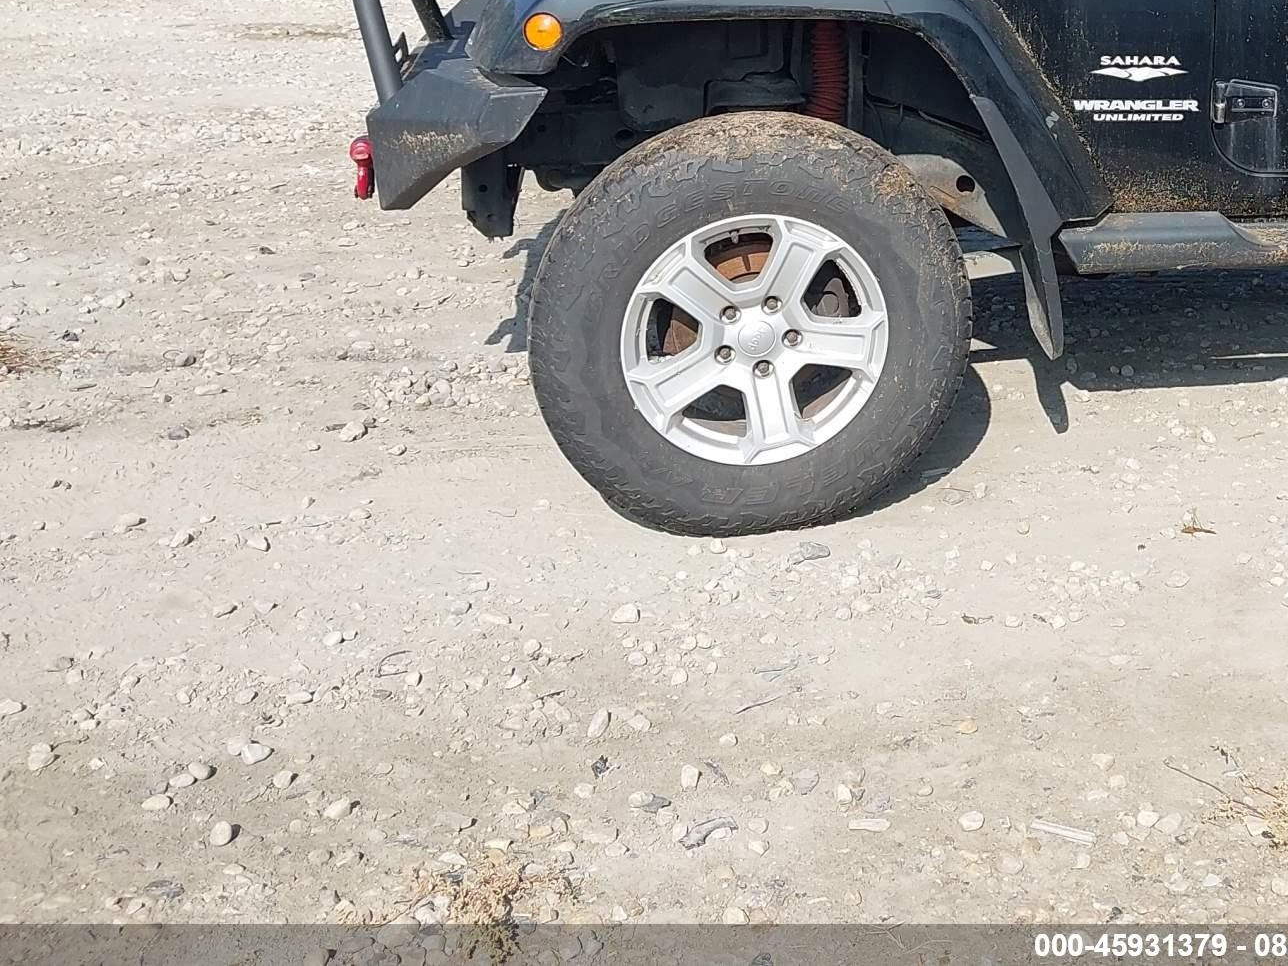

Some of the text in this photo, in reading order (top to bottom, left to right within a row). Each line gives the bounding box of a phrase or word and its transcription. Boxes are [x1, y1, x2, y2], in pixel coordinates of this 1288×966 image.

[1100, 55, 1180, 66] SAHARA
[1073, 99, 1200, 112] WRANGLER
[1093, 113, 1184, 122] UNLIMITED
